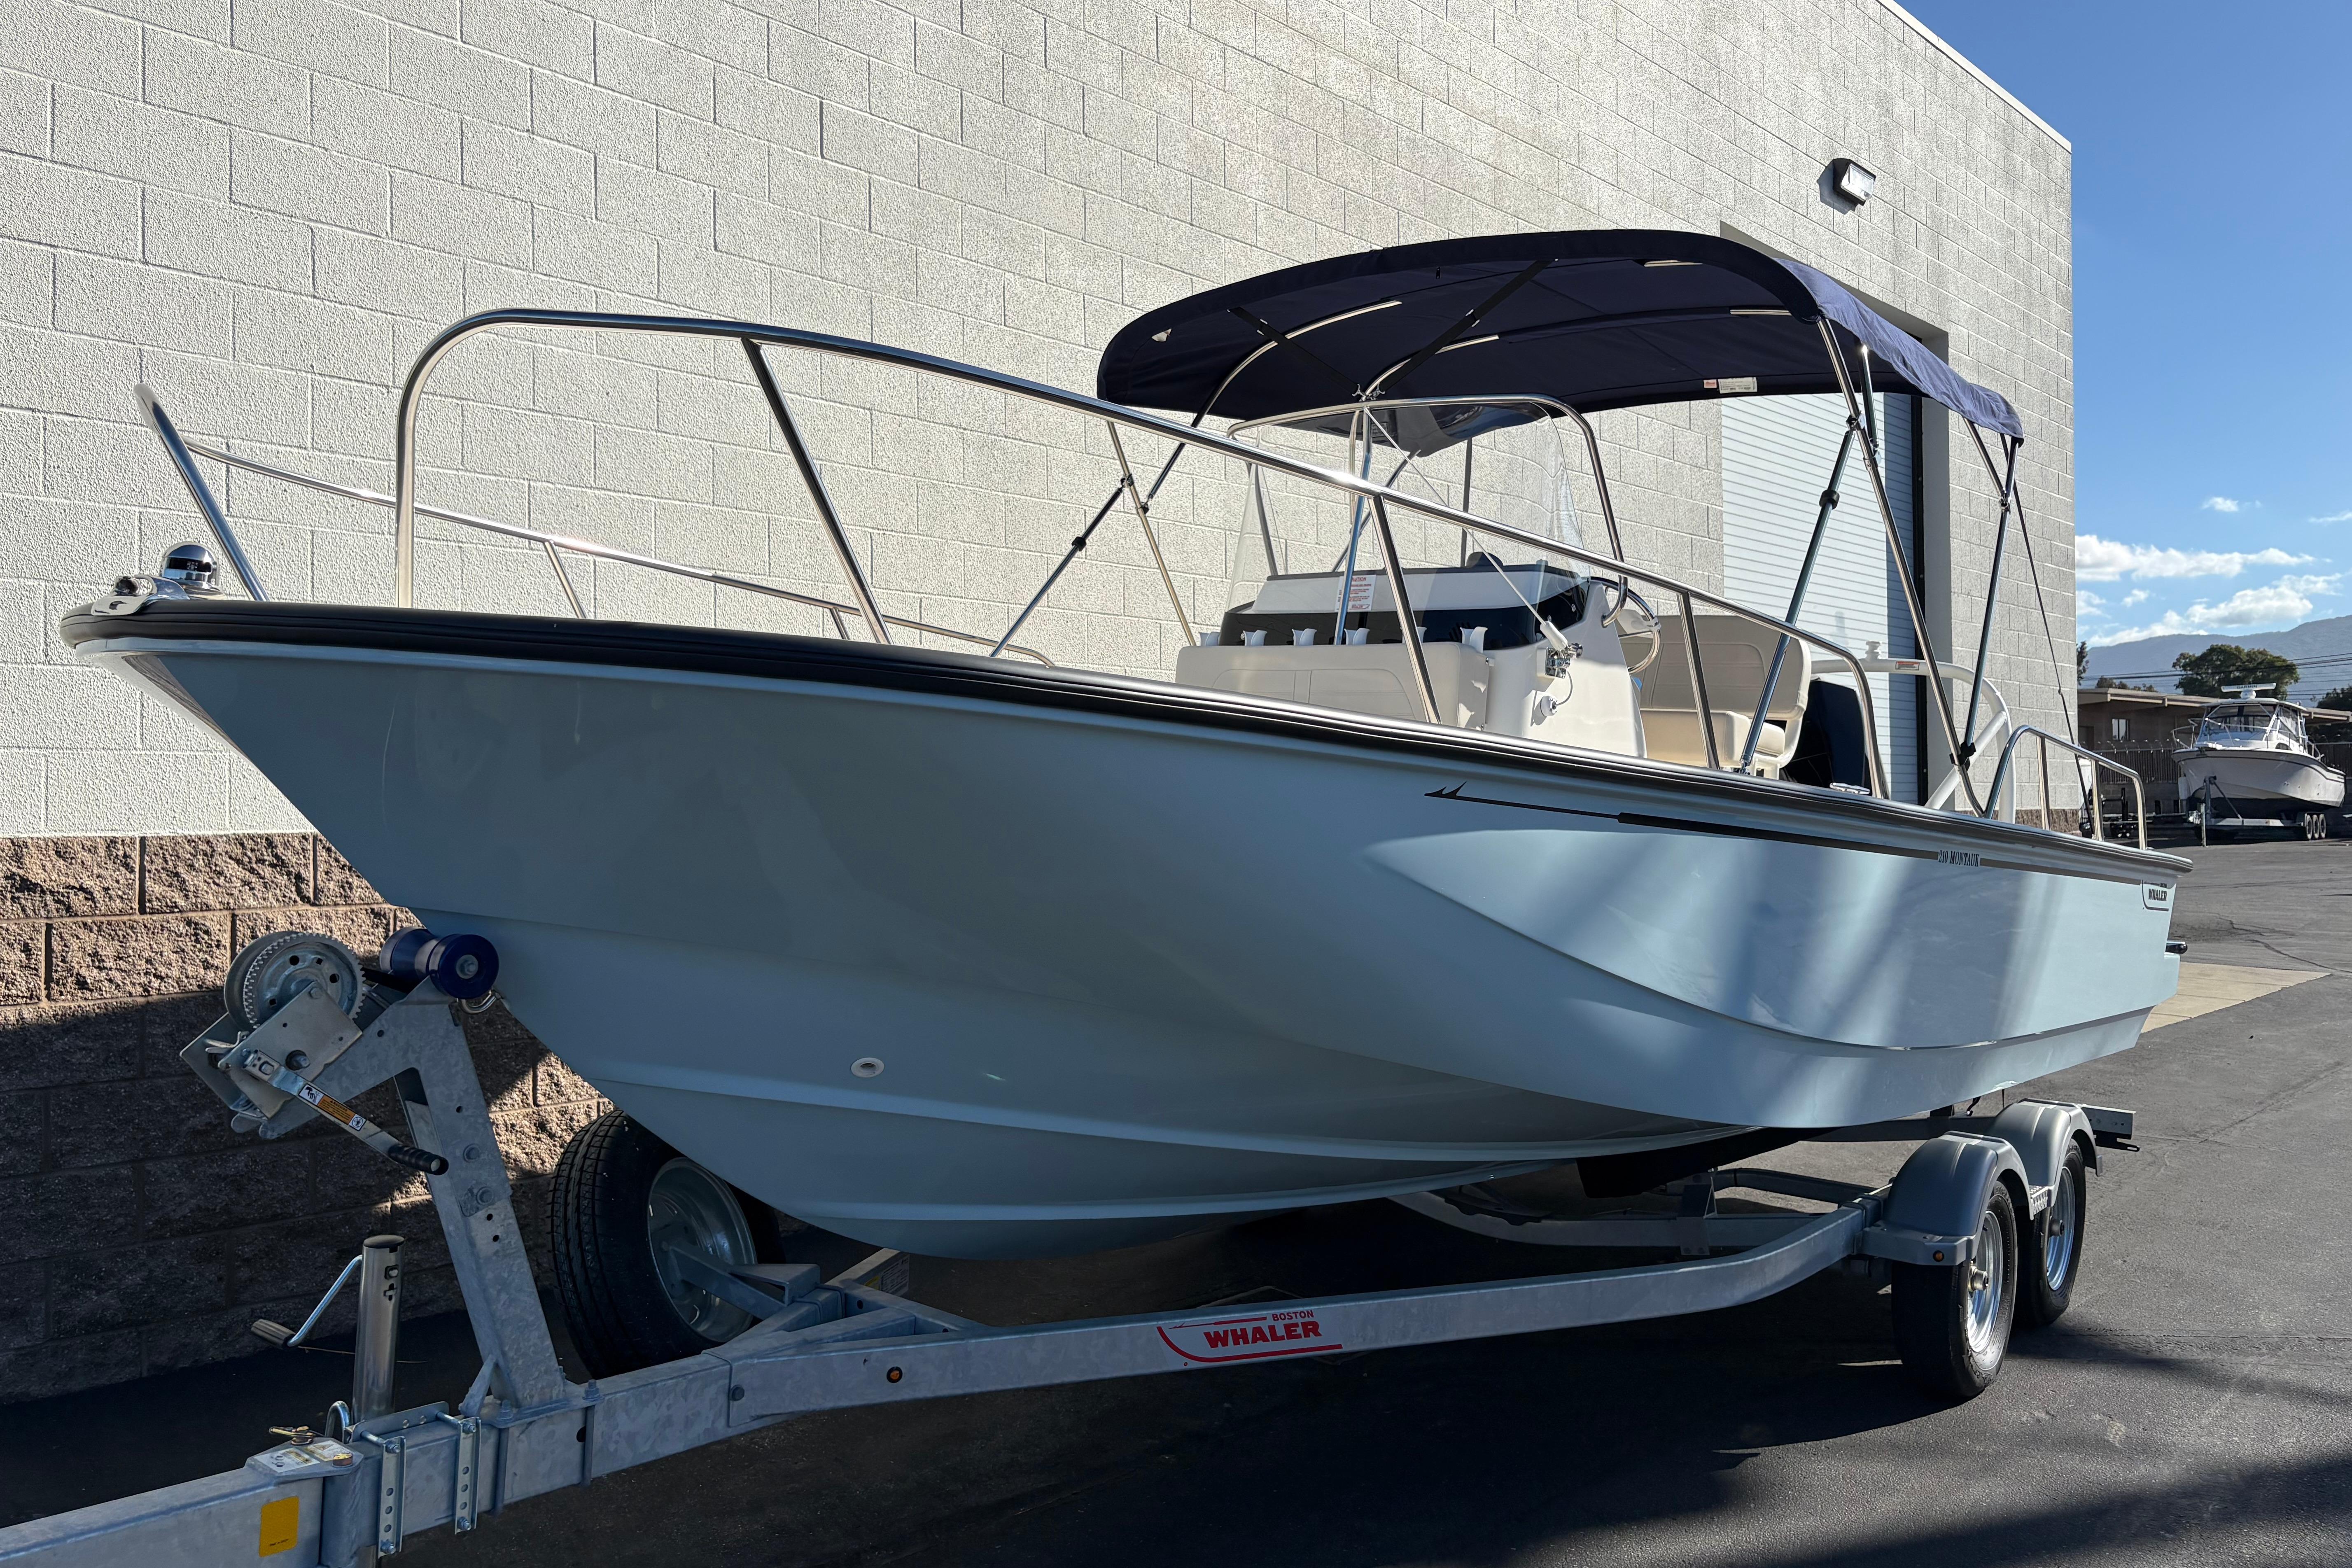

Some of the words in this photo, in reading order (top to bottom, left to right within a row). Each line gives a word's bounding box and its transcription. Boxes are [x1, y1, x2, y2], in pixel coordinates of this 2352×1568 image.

[1938, 850, 1948, 863] 210
[1949, 851, 1980, 867] MONTAUK
[2148, 888, 2167, 902] WHALER
[1272, 1310, 1314, 1321] BOSTON
[1203, 1321, 1322, 1348] WHALER
